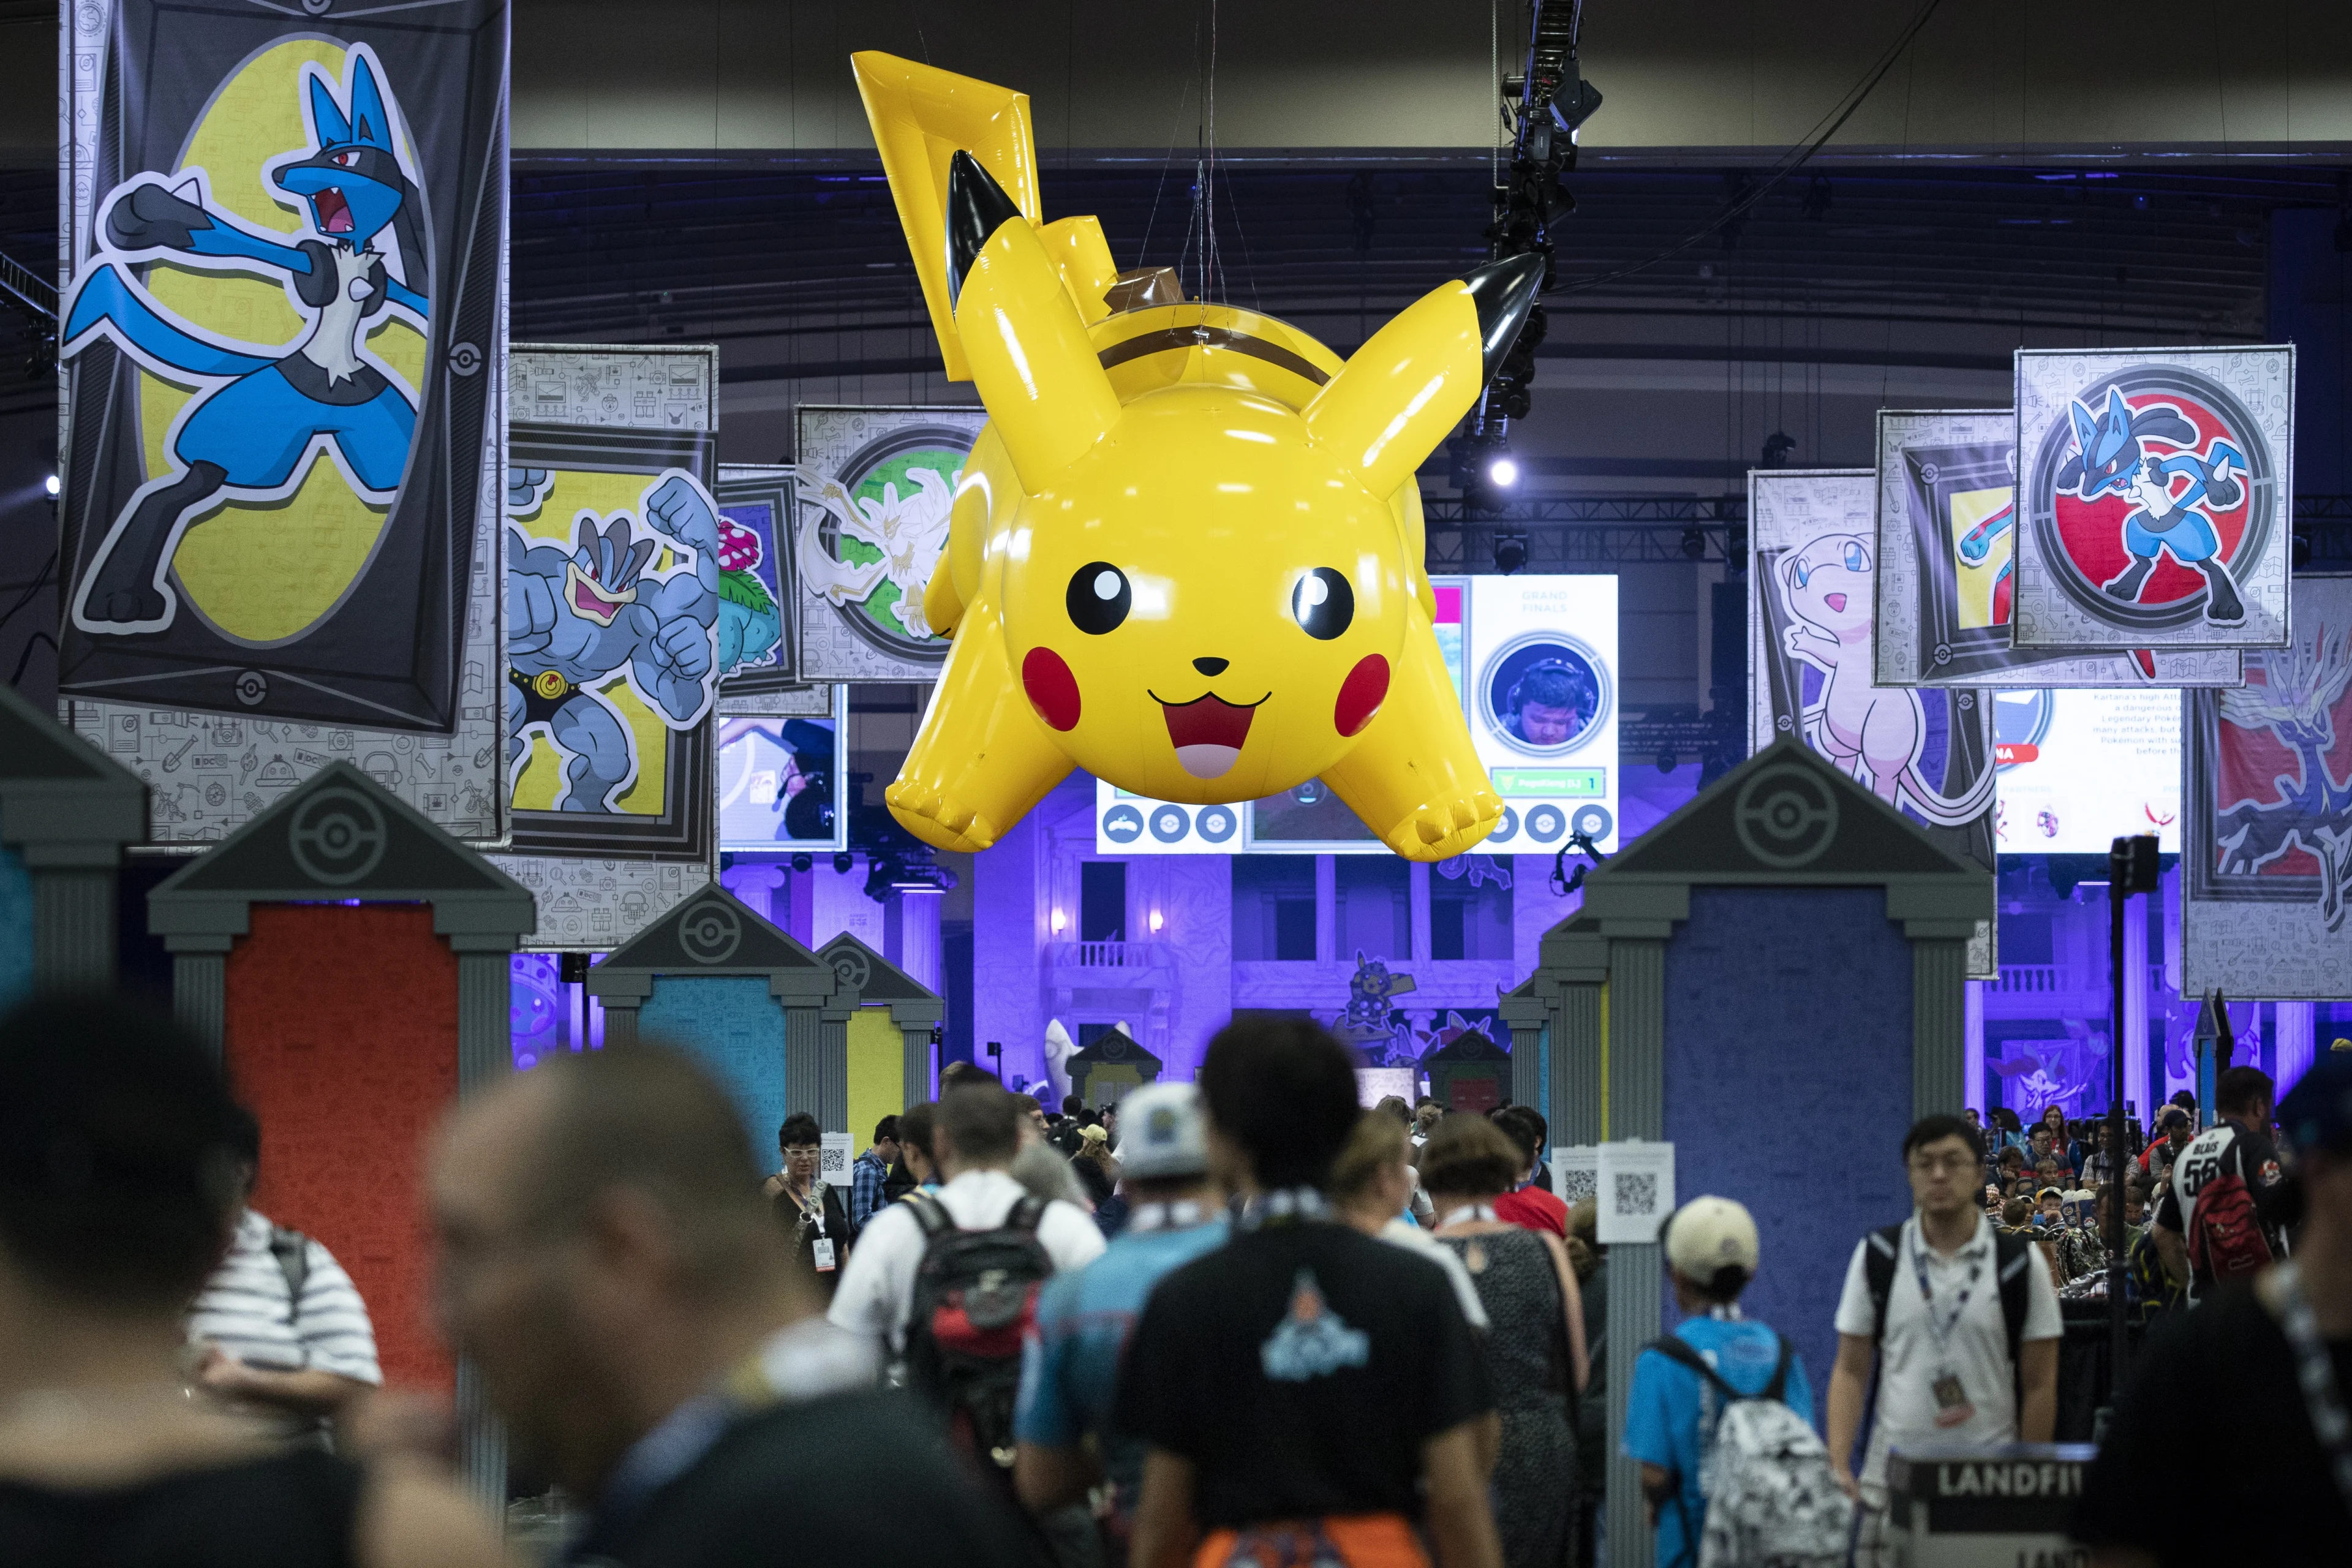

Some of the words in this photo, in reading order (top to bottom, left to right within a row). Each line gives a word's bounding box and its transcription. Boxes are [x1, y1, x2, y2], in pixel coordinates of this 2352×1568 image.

[1522, 591, 1567, 600] GRAND
[1523, 604, 1567, 612] FINALS
[1996, 747, 2015, 760] NA
[1589, 777, 1594, 790] 1
